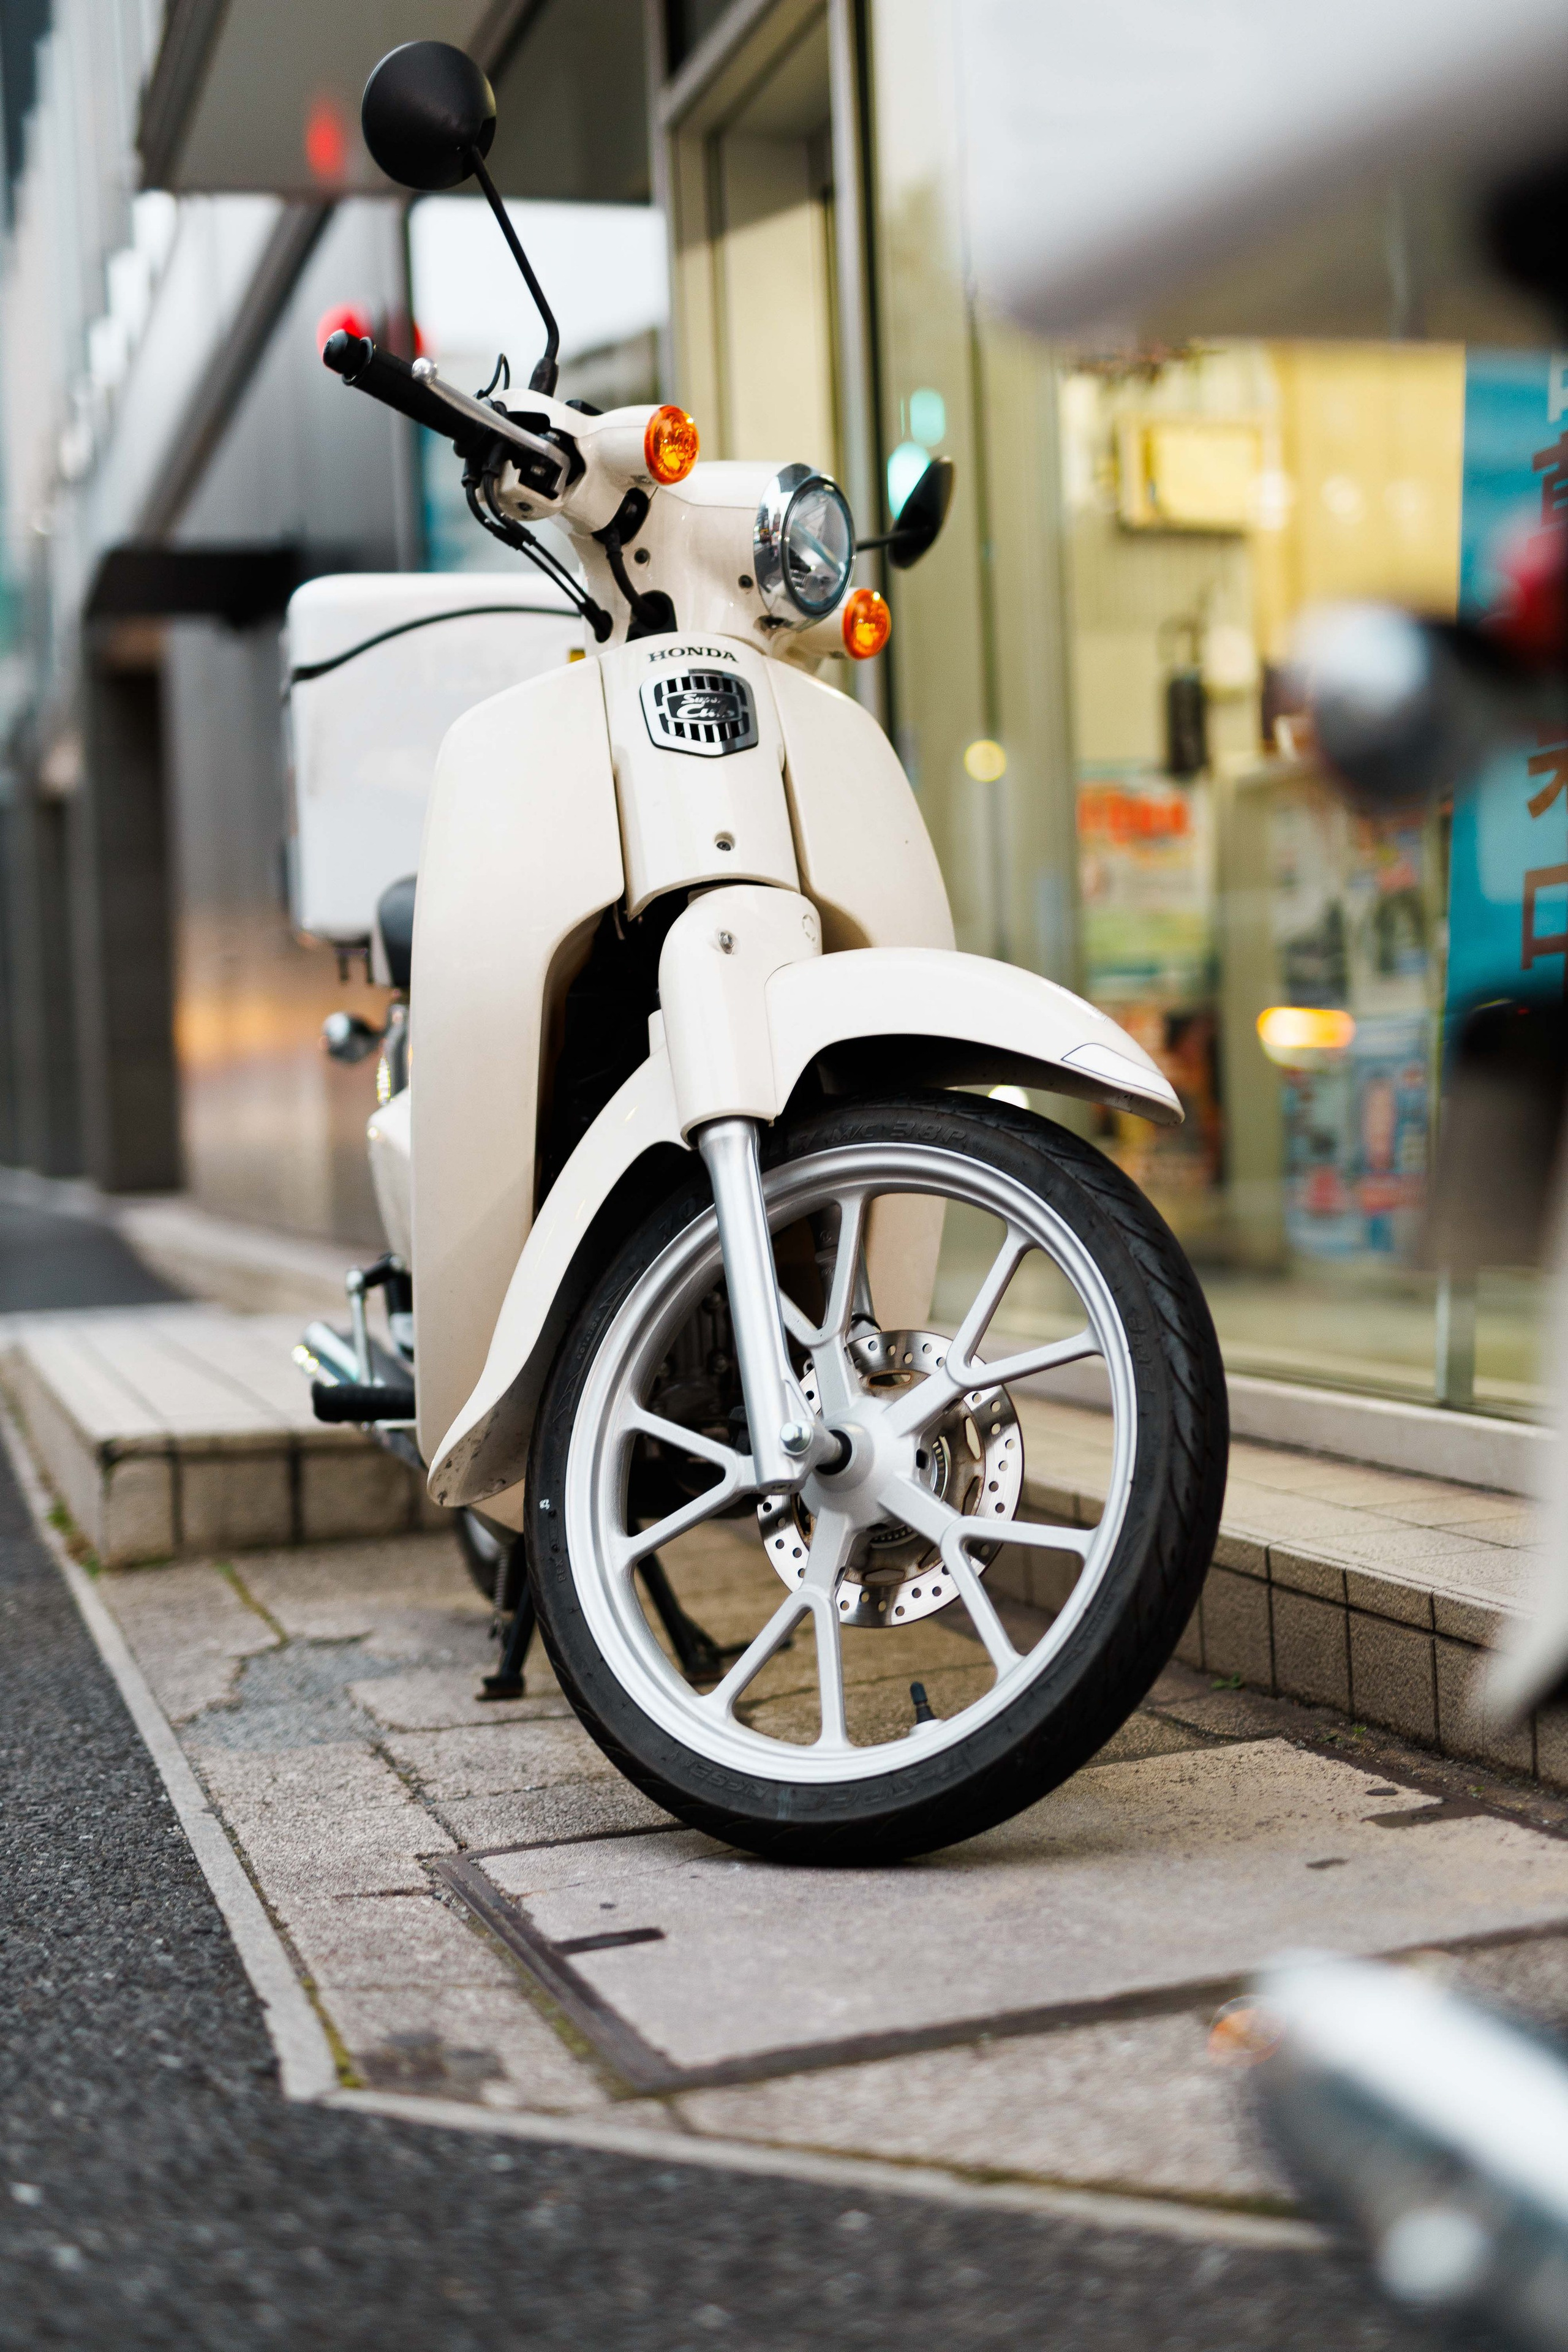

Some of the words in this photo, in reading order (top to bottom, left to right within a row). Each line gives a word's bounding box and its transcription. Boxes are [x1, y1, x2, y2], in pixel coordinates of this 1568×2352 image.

[647, 647, 739, 663] HONDA
[680, 693, 723, 707] Super
[891, 1120, 967, 1144] 38P
[576, 1317, 601, 1360] ROTATION
